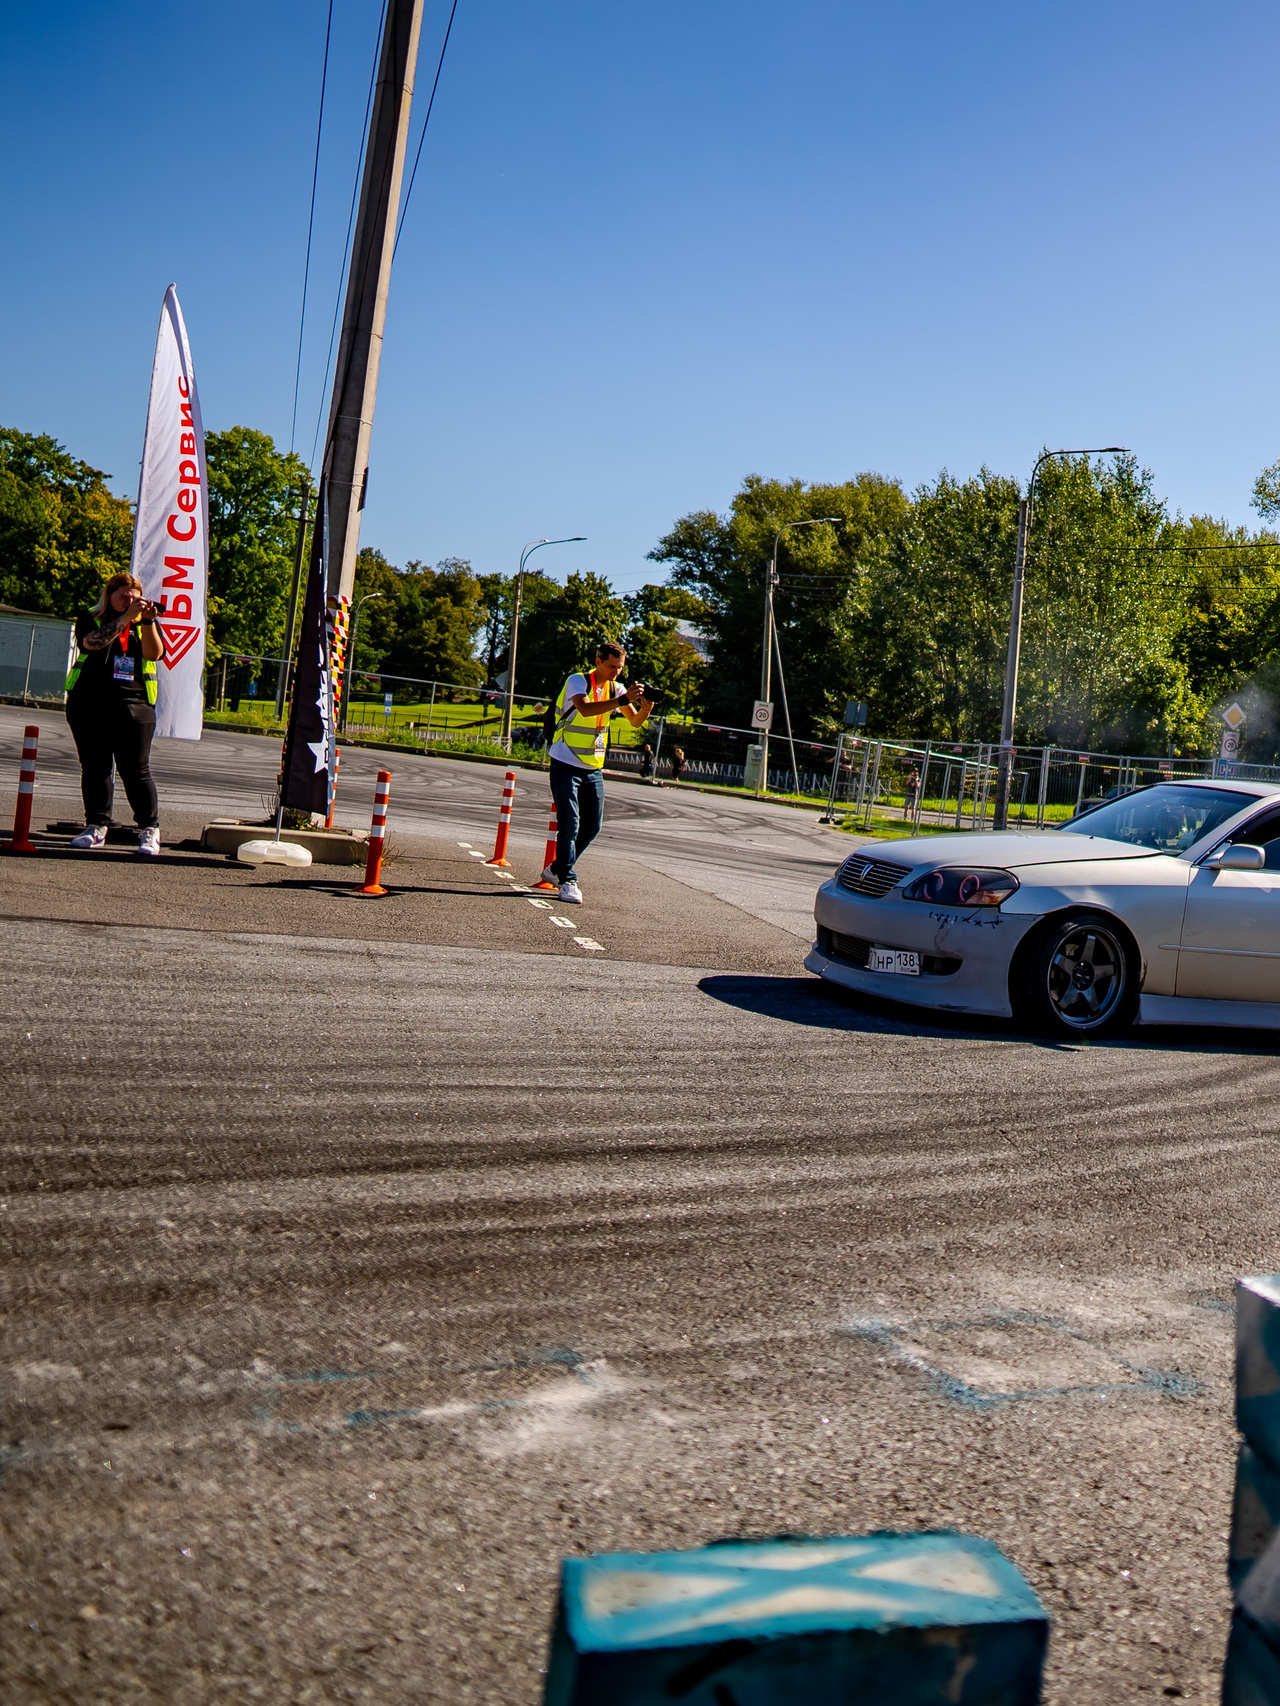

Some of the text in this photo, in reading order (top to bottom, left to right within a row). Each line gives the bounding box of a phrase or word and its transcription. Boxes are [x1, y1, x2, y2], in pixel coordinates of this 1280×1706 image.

[158, 375, 201, 621] БМ Сервис
[896, 953, 915, 968] 138
